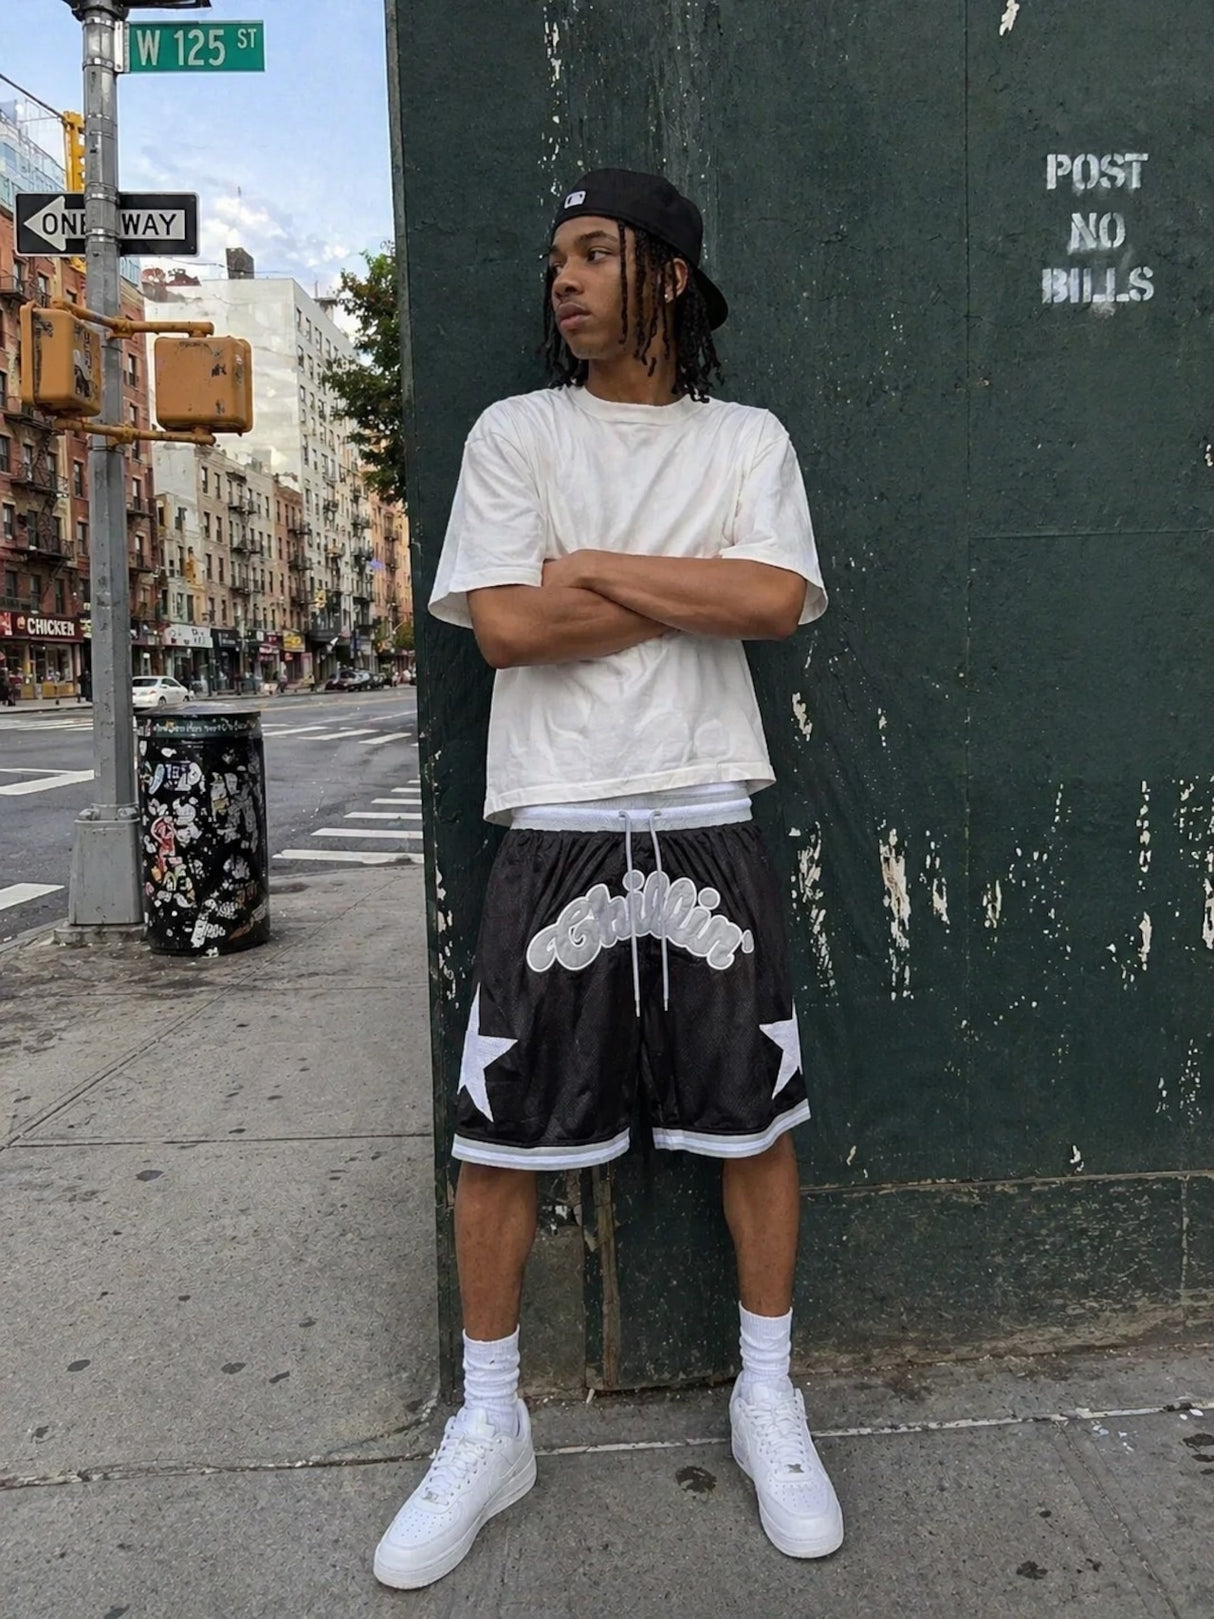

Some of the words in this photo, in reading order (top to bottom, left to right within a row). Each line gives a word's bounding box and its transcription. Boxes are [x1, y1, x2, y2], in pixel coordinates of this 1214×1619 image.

[136, 29, 161, 66] W
[173, 28, 226, 66] 125
[237, 28, 257, 49] ST
[1046, 152, 1149, 190] POST
[121, 213, 177, 236] WAY
[1070, 211, 1126, 250] NO
[1042, 266, 1155, 304] BILLS
[27, 617, 75, 636] CHICKEN
